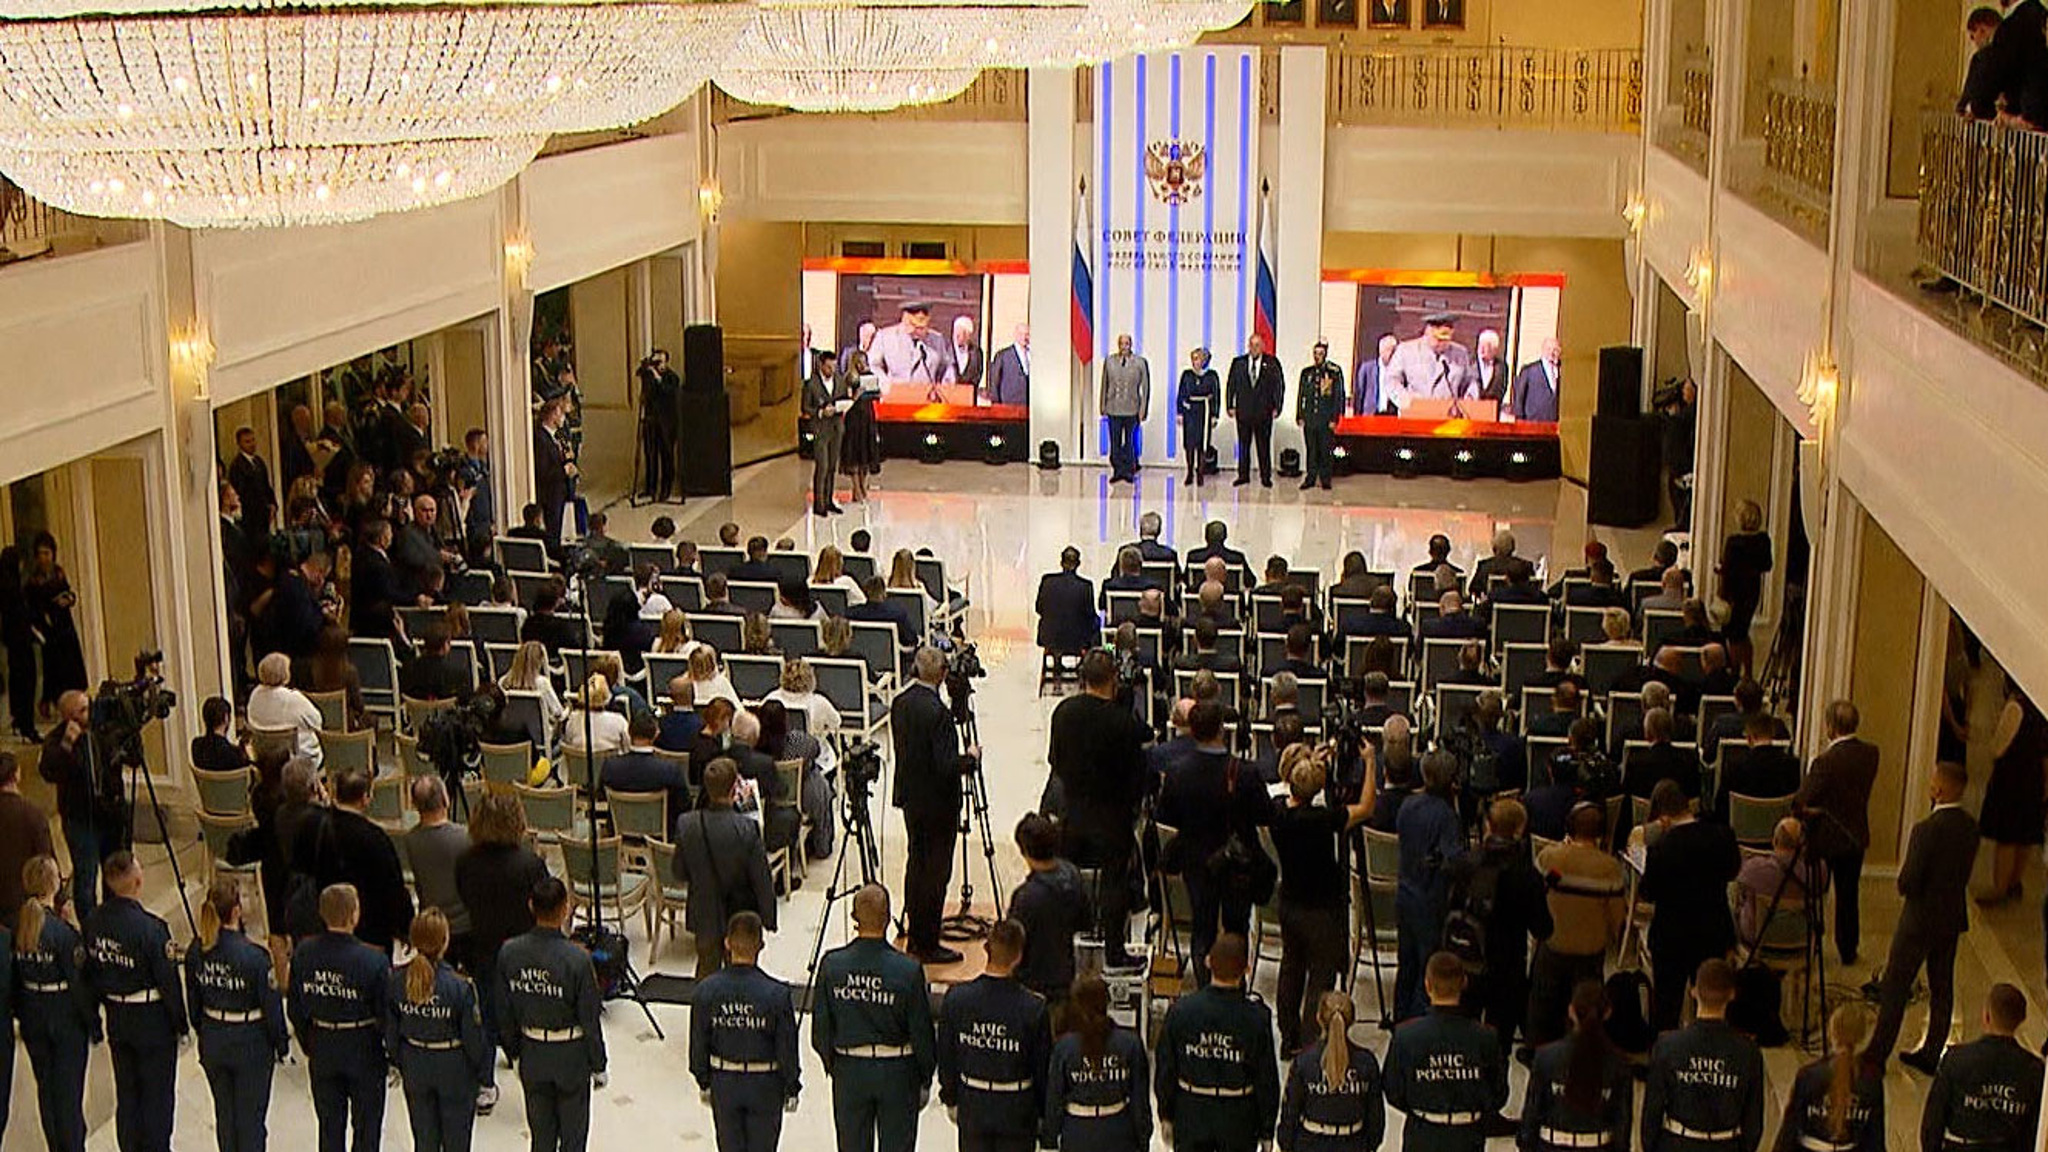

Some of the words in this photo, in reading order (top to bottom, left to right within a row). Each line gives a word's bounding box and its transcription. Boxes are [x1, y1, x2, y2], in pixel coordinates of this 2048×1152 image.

[1102, 230, 1150, 242] СОВЕТ
[1153, 230, 1246, 245] ФЕДЕРАЦИИ
[314, 970, 344, 985] МЧС
[520, 968, 549, 983] МЧС
[847, 973, 882, 990] МЧС
[303, 981, 358, 999] РОССИИ
[509, 979, 563, 998] РОССИИ
[833, 986, 895, 1005] РОССИИ
[721, 1001, 753, 1016] МЧС
[712, 1015, 767, 1030] РОССИИ
[973, 1022, 1007, 1037] МЧС
[959, 1032, 1019, 1052] РОССИИ
[1200, 1032, 1233, 1048] МЧС
[1185, 1043, 1245, 1062] РОССИИ
[1429, 1054, 1464, 1068] МЧС
[1689, 1057, 1725, 1072] МЧС
[1416, 1067, 1480, 1081] РОССИИ
[1676, 1070, 1739, 1089] РОССИИ
[1981, 1084, 2016, 1099] МЧС
[1964, 1094, 2027, 1115] РОССИИ
